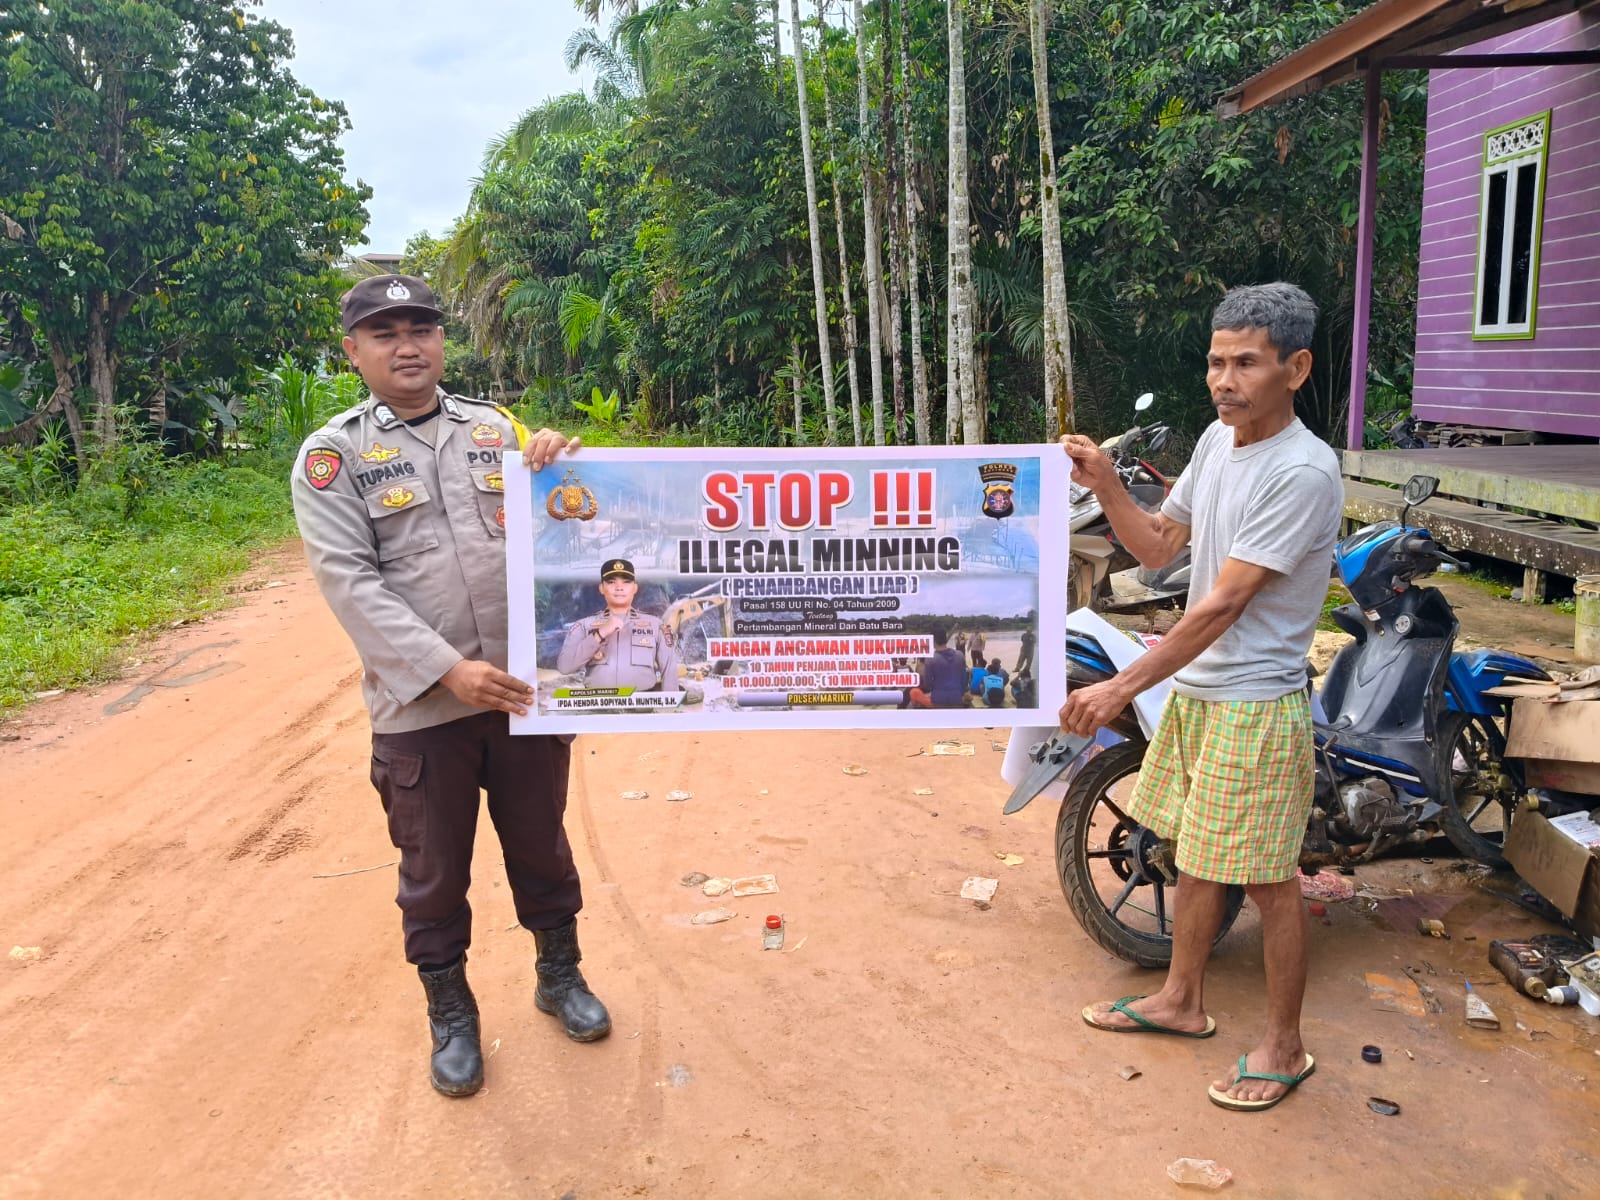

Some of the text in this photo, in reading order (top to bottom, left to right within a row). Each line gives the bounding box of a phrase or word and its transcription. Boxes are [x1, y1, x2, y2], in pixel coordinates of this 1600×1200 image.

[468, 450, 502, 464] POL
[356, 461, 415, 489] TUPANG
[703, 470, 933, 530] STOP !!!
[679, 537, 960, 574] ILLEGAL MINNING
[743, 600, 897, 610] Pasal 158 UU RI No. 04 Tahun 2009
[807, 611, 834, 620] Tentang
[737, 621, 903, 634] Pertambangan Mineral Dan Batu Bara
[711, 639, 930, 657] DENGAN ANCAMAN HUKUMAN
[750, 661, 891, 673] 10 TAHUN PENJARA DAN DENDA
[723, 678, 737, 688] RP.
[841, 676, 874, 686] MILYAR
[574, 699, 599, 707] HENDRA
[600, 698, 627, 706] SOPIYAN
[788, 693, 854, 704] POLSEK MARIKIT
